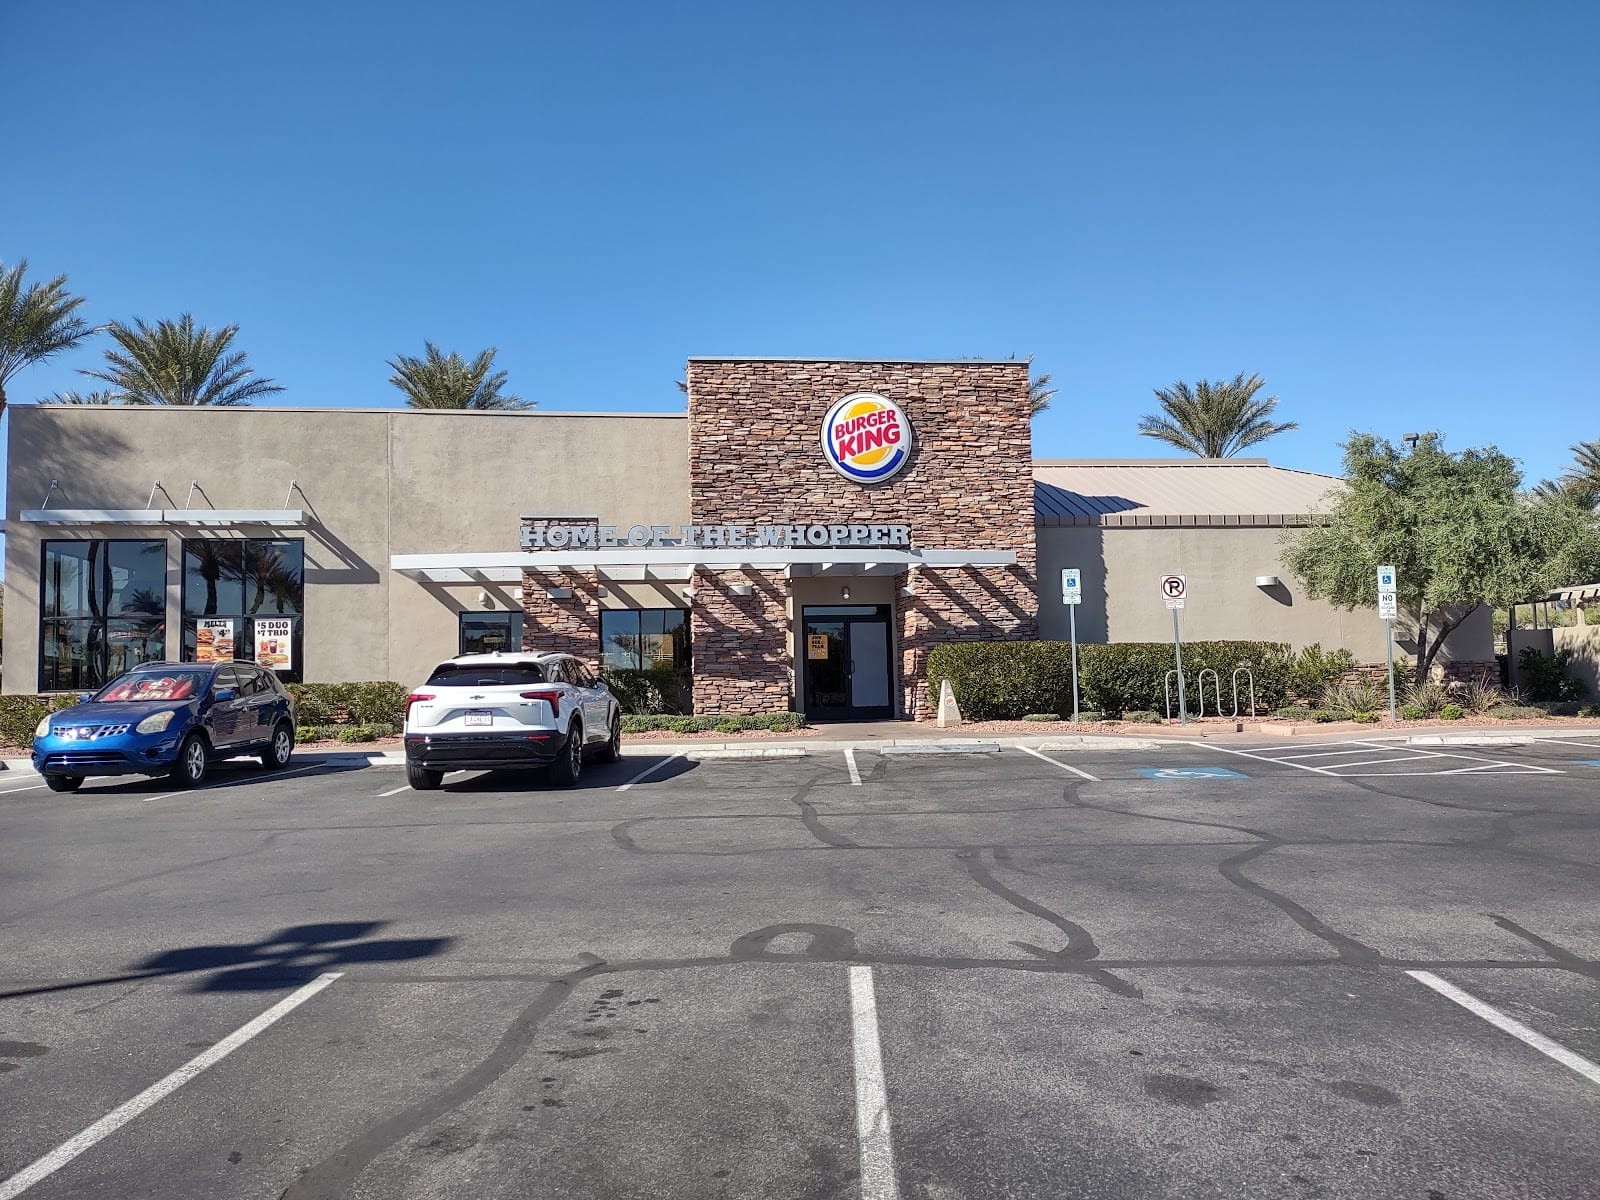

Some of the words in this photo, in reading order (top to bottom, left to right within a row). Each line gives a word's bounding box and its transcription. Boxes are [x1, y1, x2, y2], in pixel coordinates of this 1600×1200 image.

[835, 409, 897, 440] BURGER
[839, 423, 901, 461] KING
[520, 525, 618, 547] HOME
[628, 525, 671, 547] OF
[681, 525, 748, 547] THE
[756, 524, 911, 546] WHOPPER
[1382, 594, 1393, 602] NO
[257, 621, 266, 629] $5
[268, 621, 289, 629] DUO
[257, 629, 266, 637] $7
[267, 629, 289, 637] TRIO
